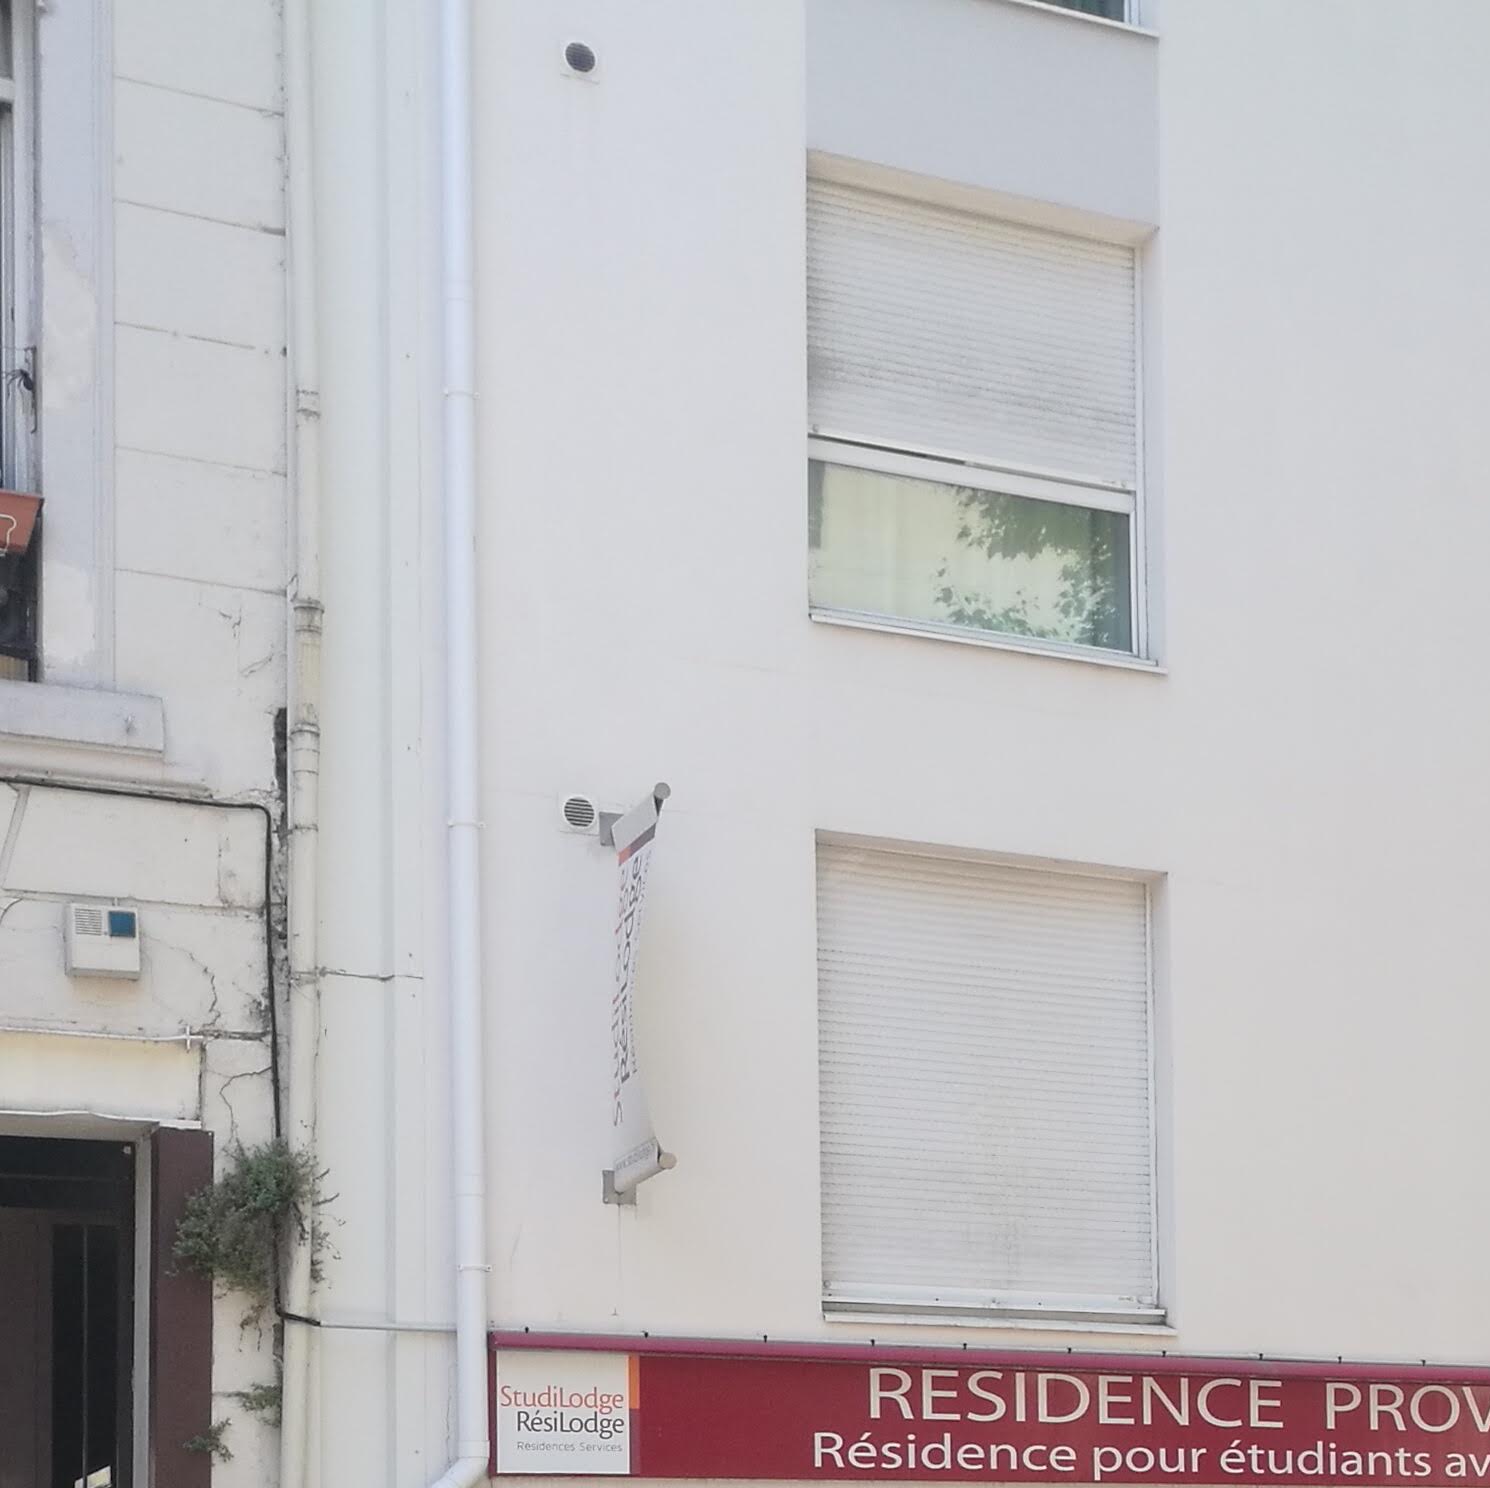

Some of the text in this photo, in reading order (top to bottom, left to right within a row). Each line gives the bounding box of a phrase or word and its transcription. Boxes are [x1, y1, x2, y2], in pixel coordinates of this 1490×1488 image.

[501, 1385, 625, 1415] StudiLodge
[867, 1366, 1284, 1430] RESIDENCE
[517, 1410, 625, 1440] RésiLodge
[579, 1441, 623, 1452] Services
[813, 1431, 1076, 1472] Résidence
[1094, 1438, 1206, 1481] pour
[1221, 1440, 1432, 1478] étudiants
